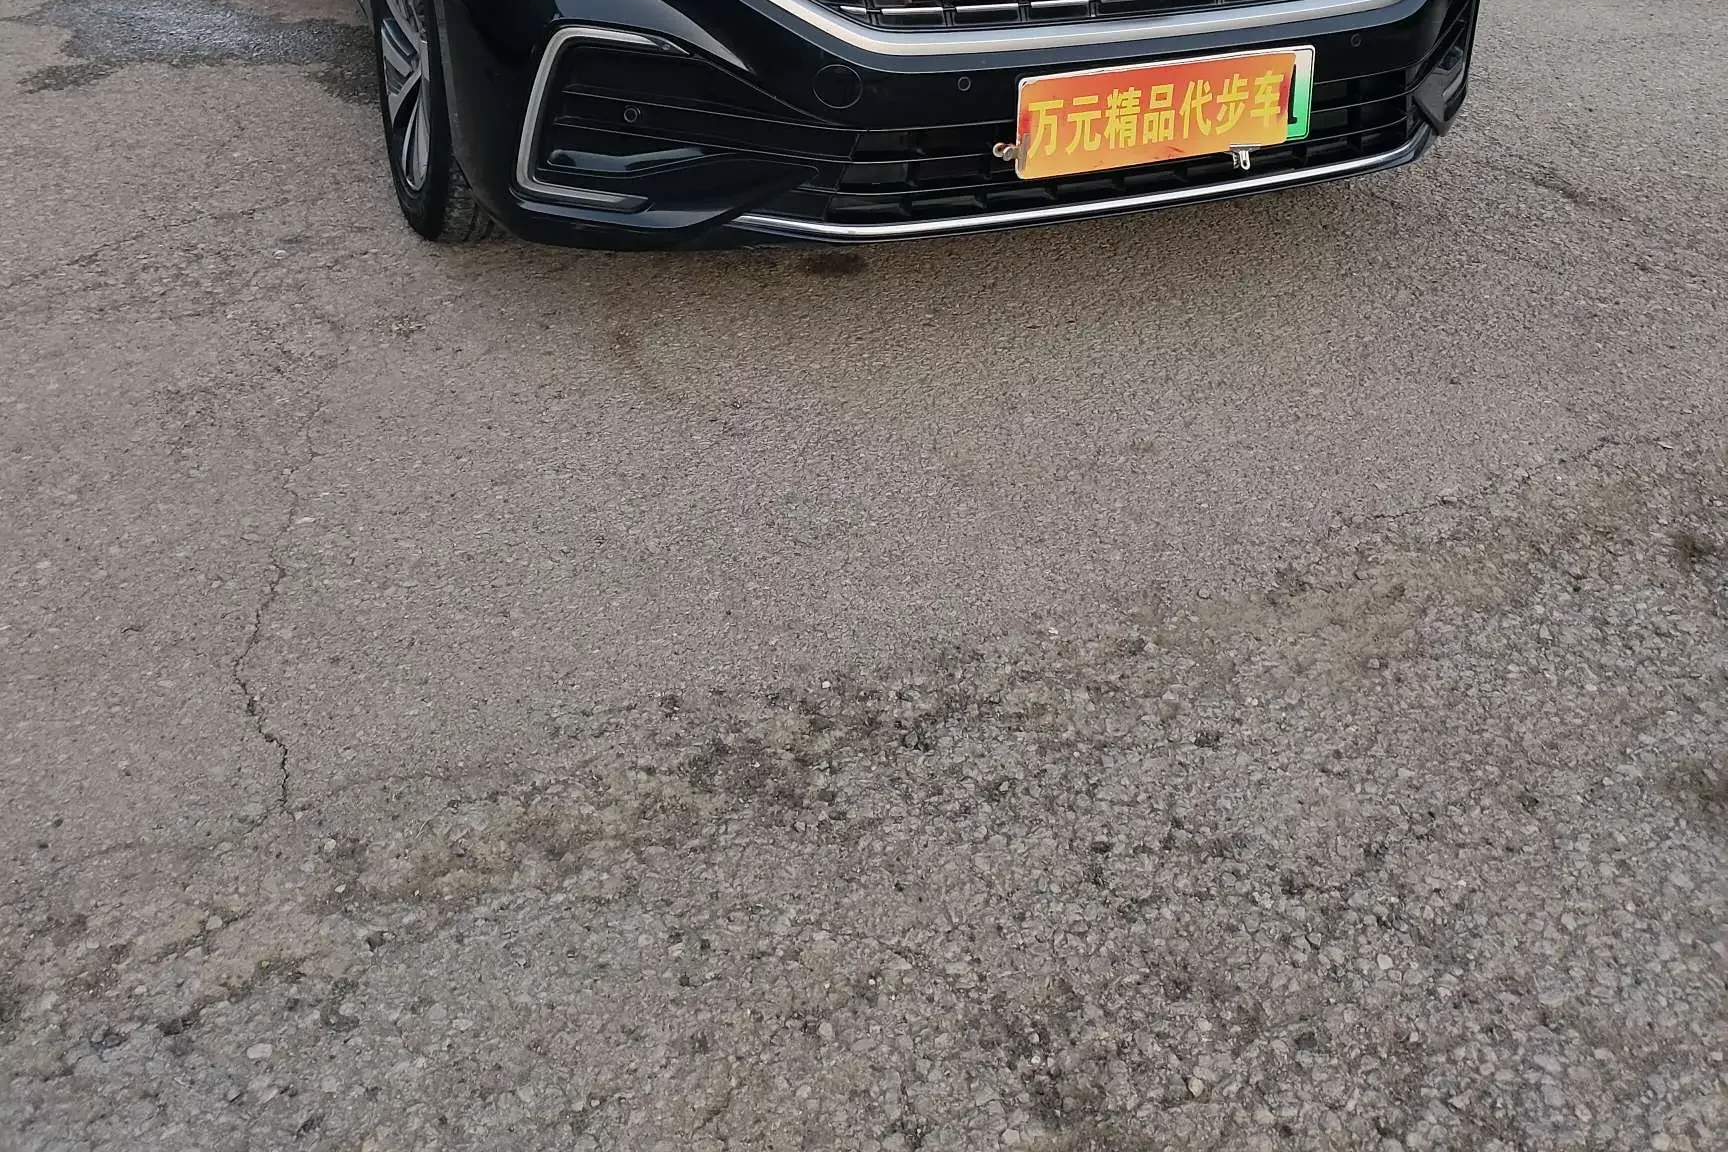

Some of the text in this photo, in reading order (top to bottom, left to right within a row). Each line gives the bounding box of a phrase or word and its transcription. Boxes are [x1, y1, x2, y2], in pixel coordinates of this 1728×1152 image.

[1025, 70, 1285, 161] 万元精品代步车
